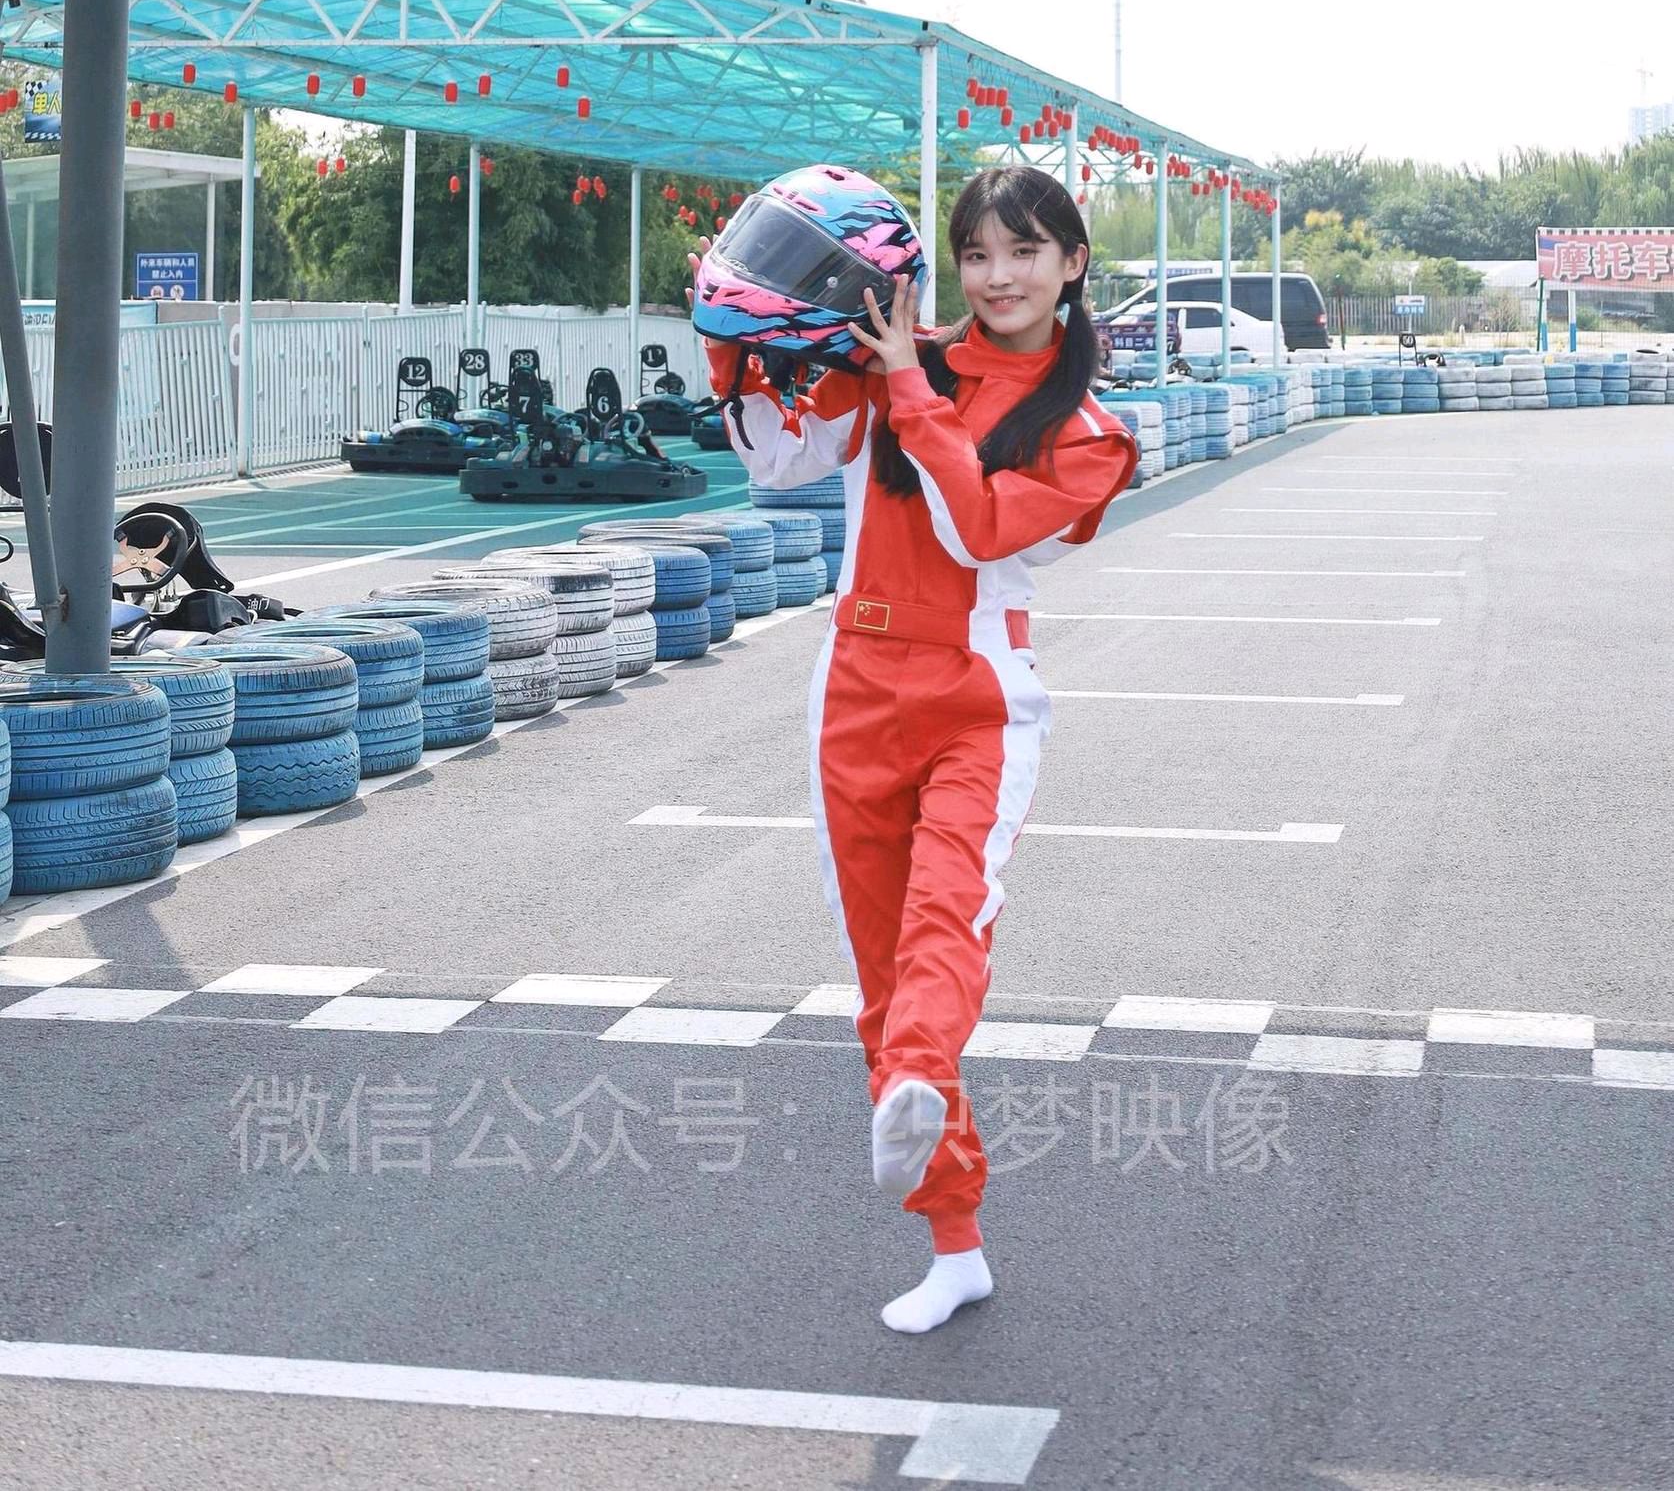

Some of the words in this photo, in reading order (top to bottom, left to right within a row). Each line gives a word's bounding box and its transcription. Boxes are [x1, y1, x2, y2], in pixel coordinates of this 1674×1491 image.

[1552, 240, 1674, 281] 摩托车
[465, 353, 485, 370] 28
[406, 364, 426, 380] 12
[518, 395, 531, 414] 7
[597, 395, 610, 414] 6
